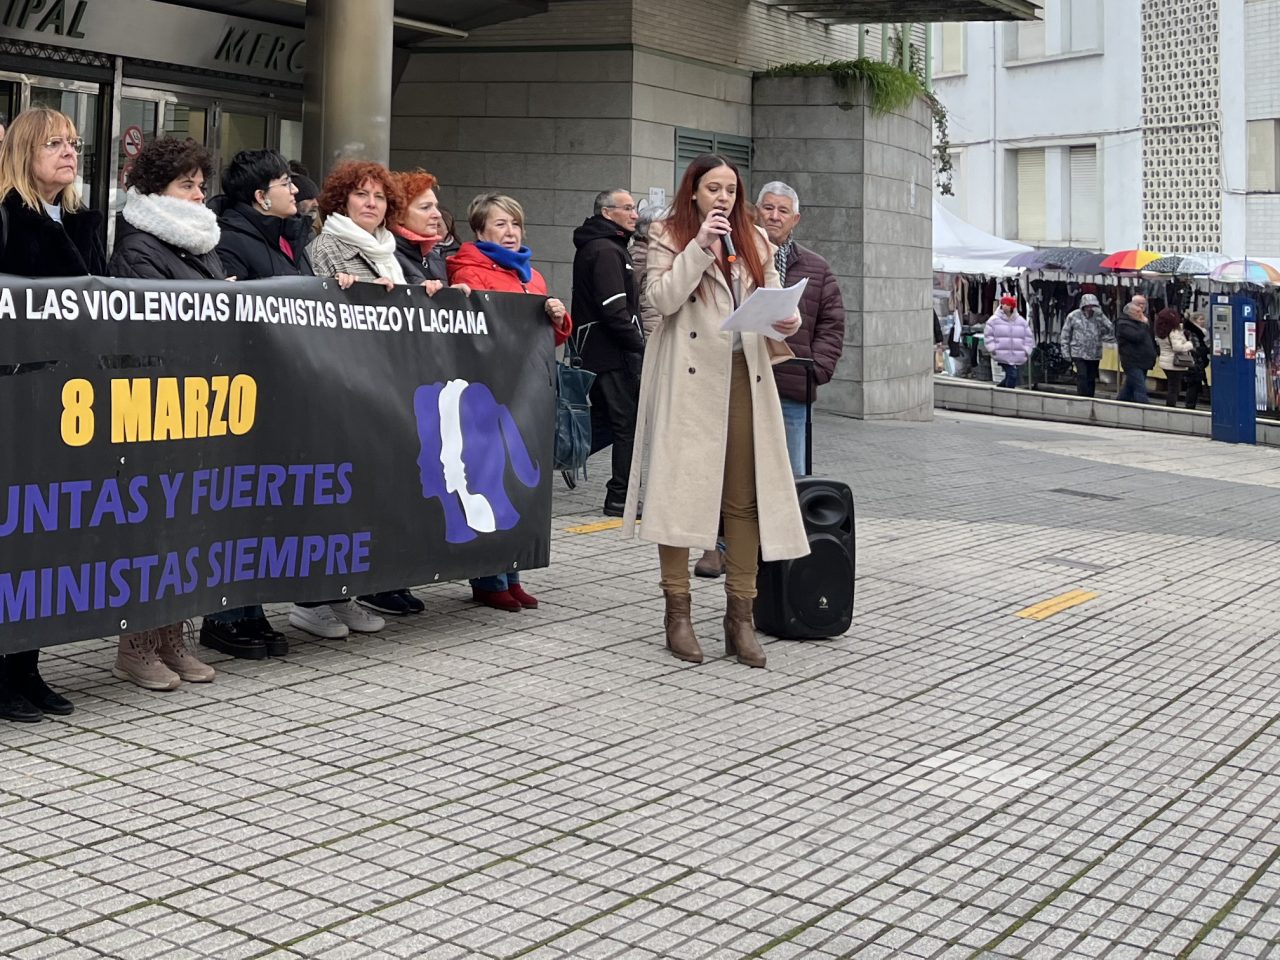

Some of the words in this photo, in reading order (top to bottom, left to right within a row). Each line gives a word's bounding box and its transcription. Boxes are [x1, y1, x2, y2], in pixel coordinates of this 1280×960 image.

[214, 26, 305, 73] MERC
[25, 288, 79, 320] LAS
[82, 290, 230, 322] VIOLENCIAS
[235, 294, 337, 330] MACHISTAS
[339, 303, 402, 332] BIERZO
[404, 307, 416, 331] Y
[419, 307, 488, 335] LACIANA
[1244, 306, 1252, 317] P
[60, 378, 95, 447] 8
[110, 374, 257, 444] MARZO
[158, 472, 184, 519] Y
[191, 462, 354, 515] FUERTES
[206, 531, 372, 588] SIEMPRE
